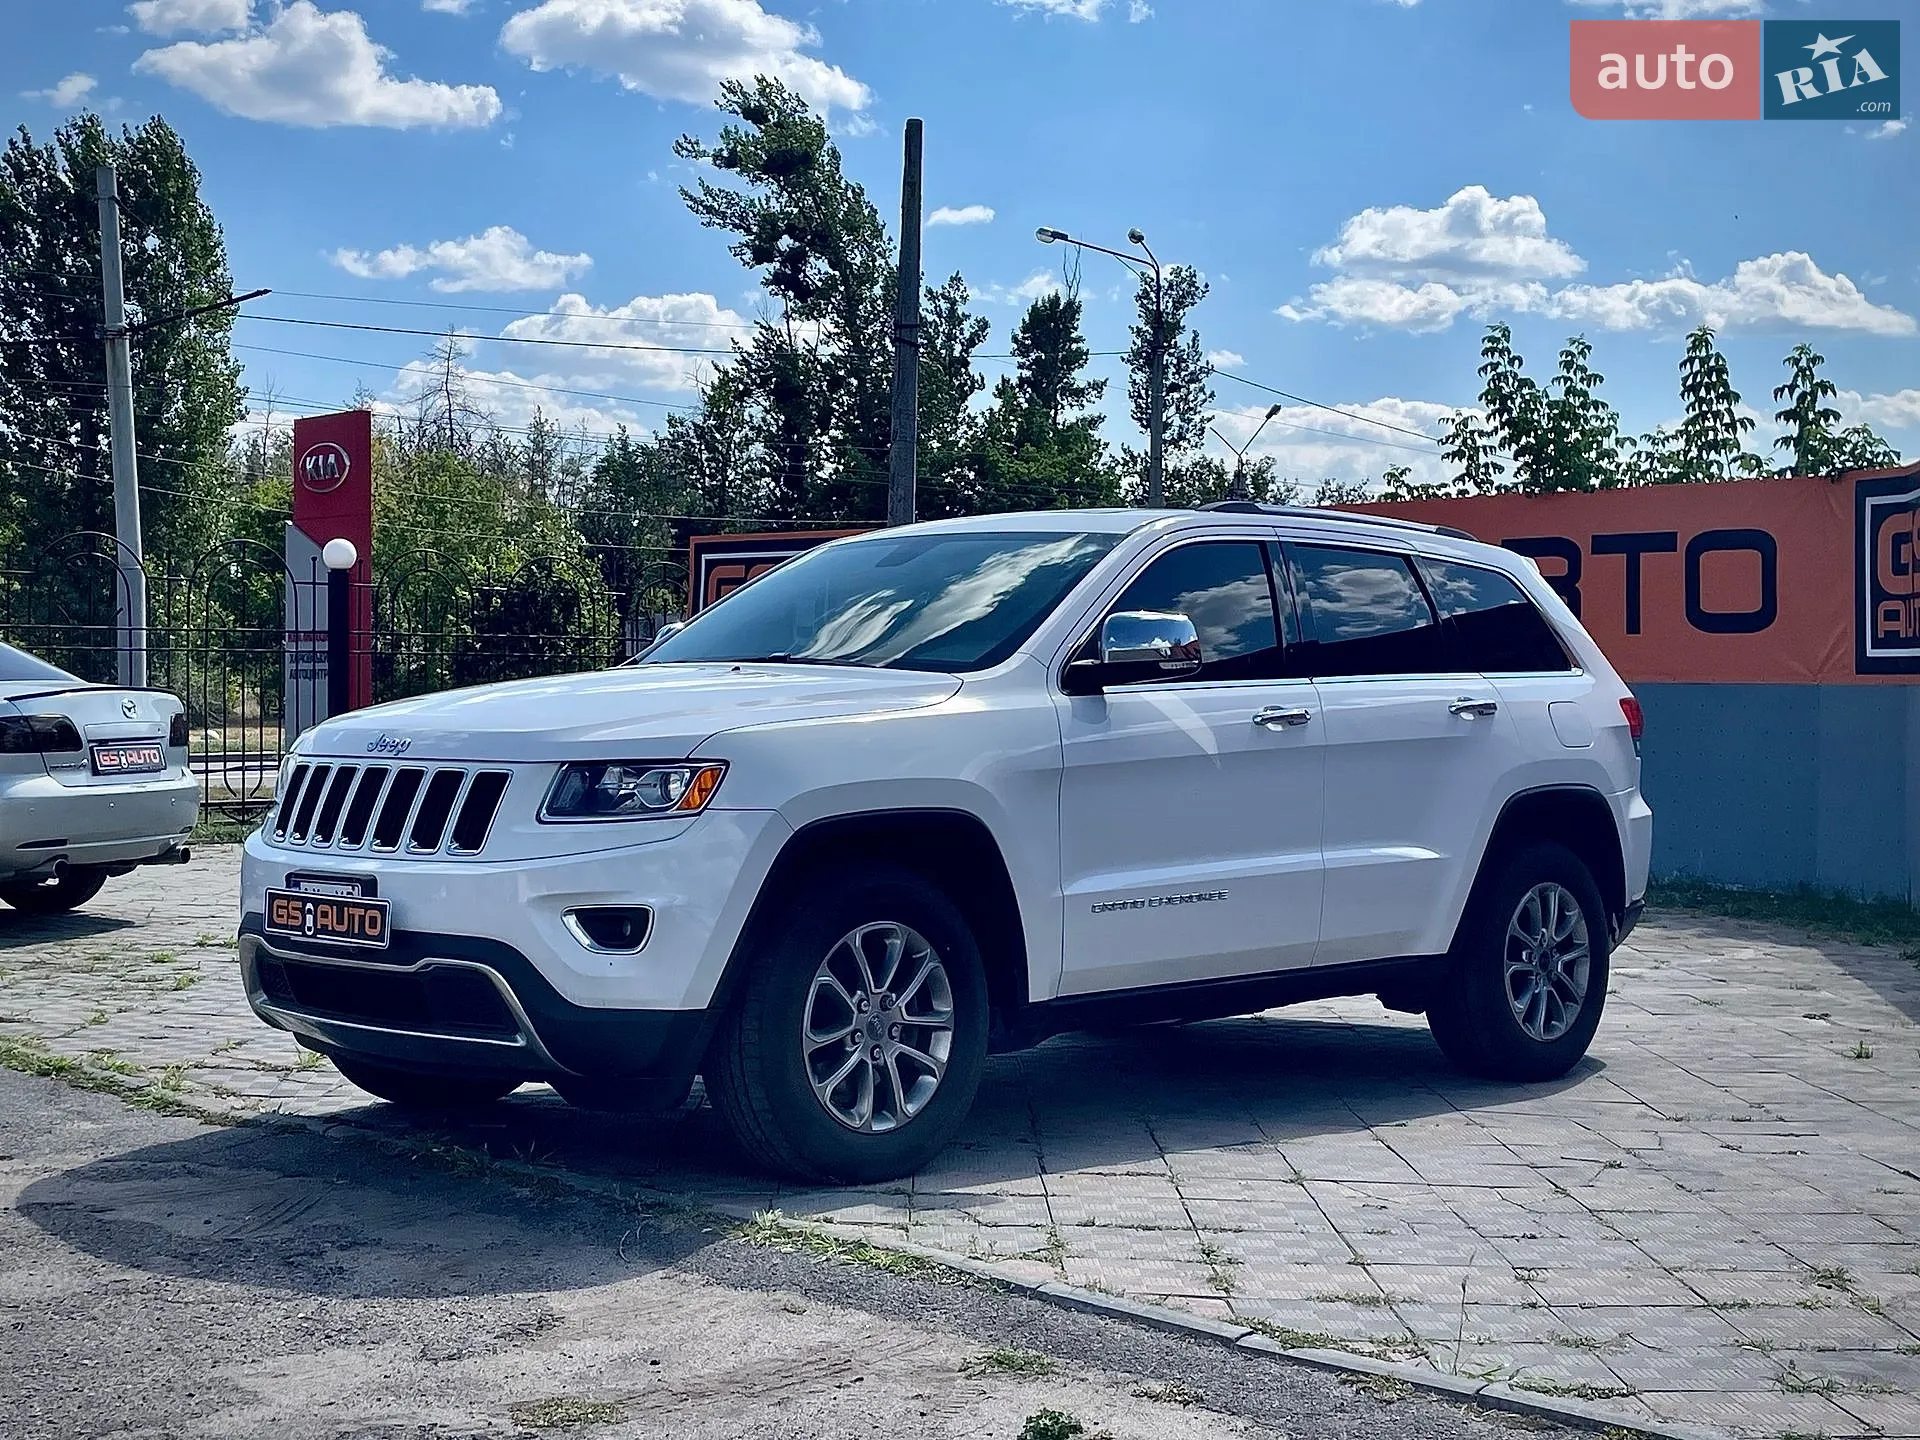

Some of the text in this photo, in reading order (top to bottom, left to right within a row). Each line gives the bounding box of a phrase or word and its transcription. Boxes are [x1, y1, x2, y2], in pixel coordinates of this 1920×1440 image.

[306, 453, 340, 481] KIA
[1877, 510, 1920, 595] G
[100, 751, 119, 766] GS
[126, 749, 160, 764] AUTO
[367, 733, 412, 756] Jeep
[1091, 888, 1229, 913] GRAND CHEROKEE
[272, 898, 382, 936] GS AUTO
